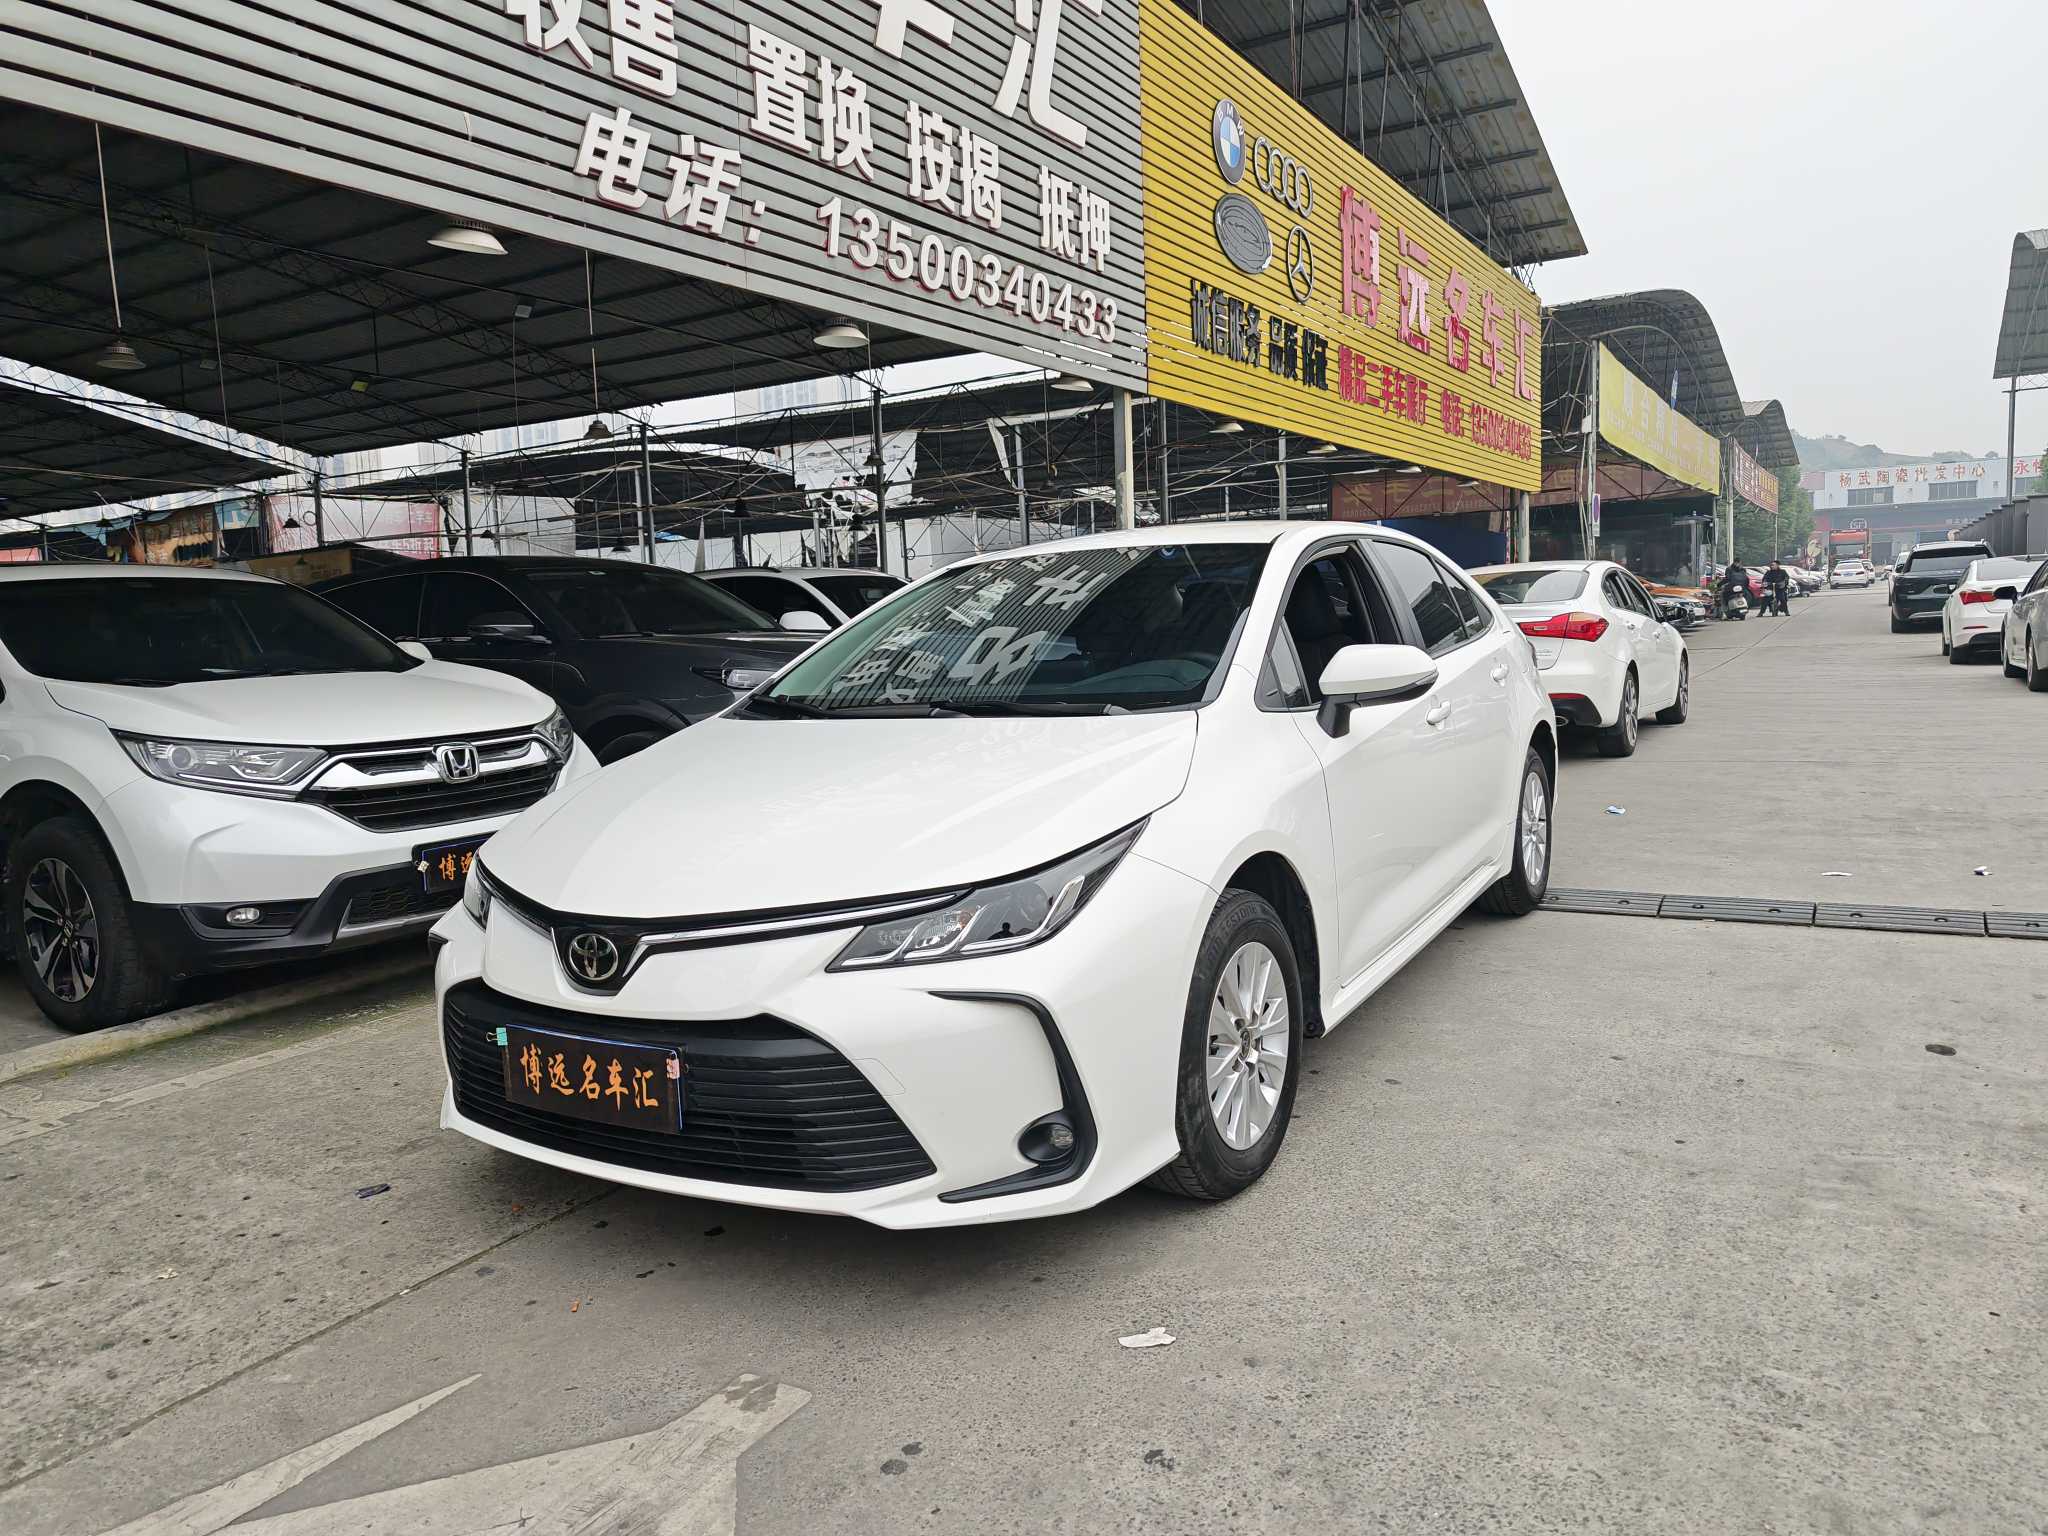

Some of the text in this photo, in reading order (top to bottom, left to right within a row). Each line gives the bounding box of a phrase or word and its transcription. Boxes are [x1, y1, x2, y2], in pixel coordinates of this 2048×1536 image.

[746, 23, 875, 181] 置换
[905, 99, 1003, 229] 按揭
[1039, 164, 1112, 272] 抵押
[873, 0, 1102, 149] 汇
[815, 195, 1119, 344] 13500340433
[1339, 184, 1534, 402] 博远名车汇
[520, 1043, 660, 1112] 博远名车汇
